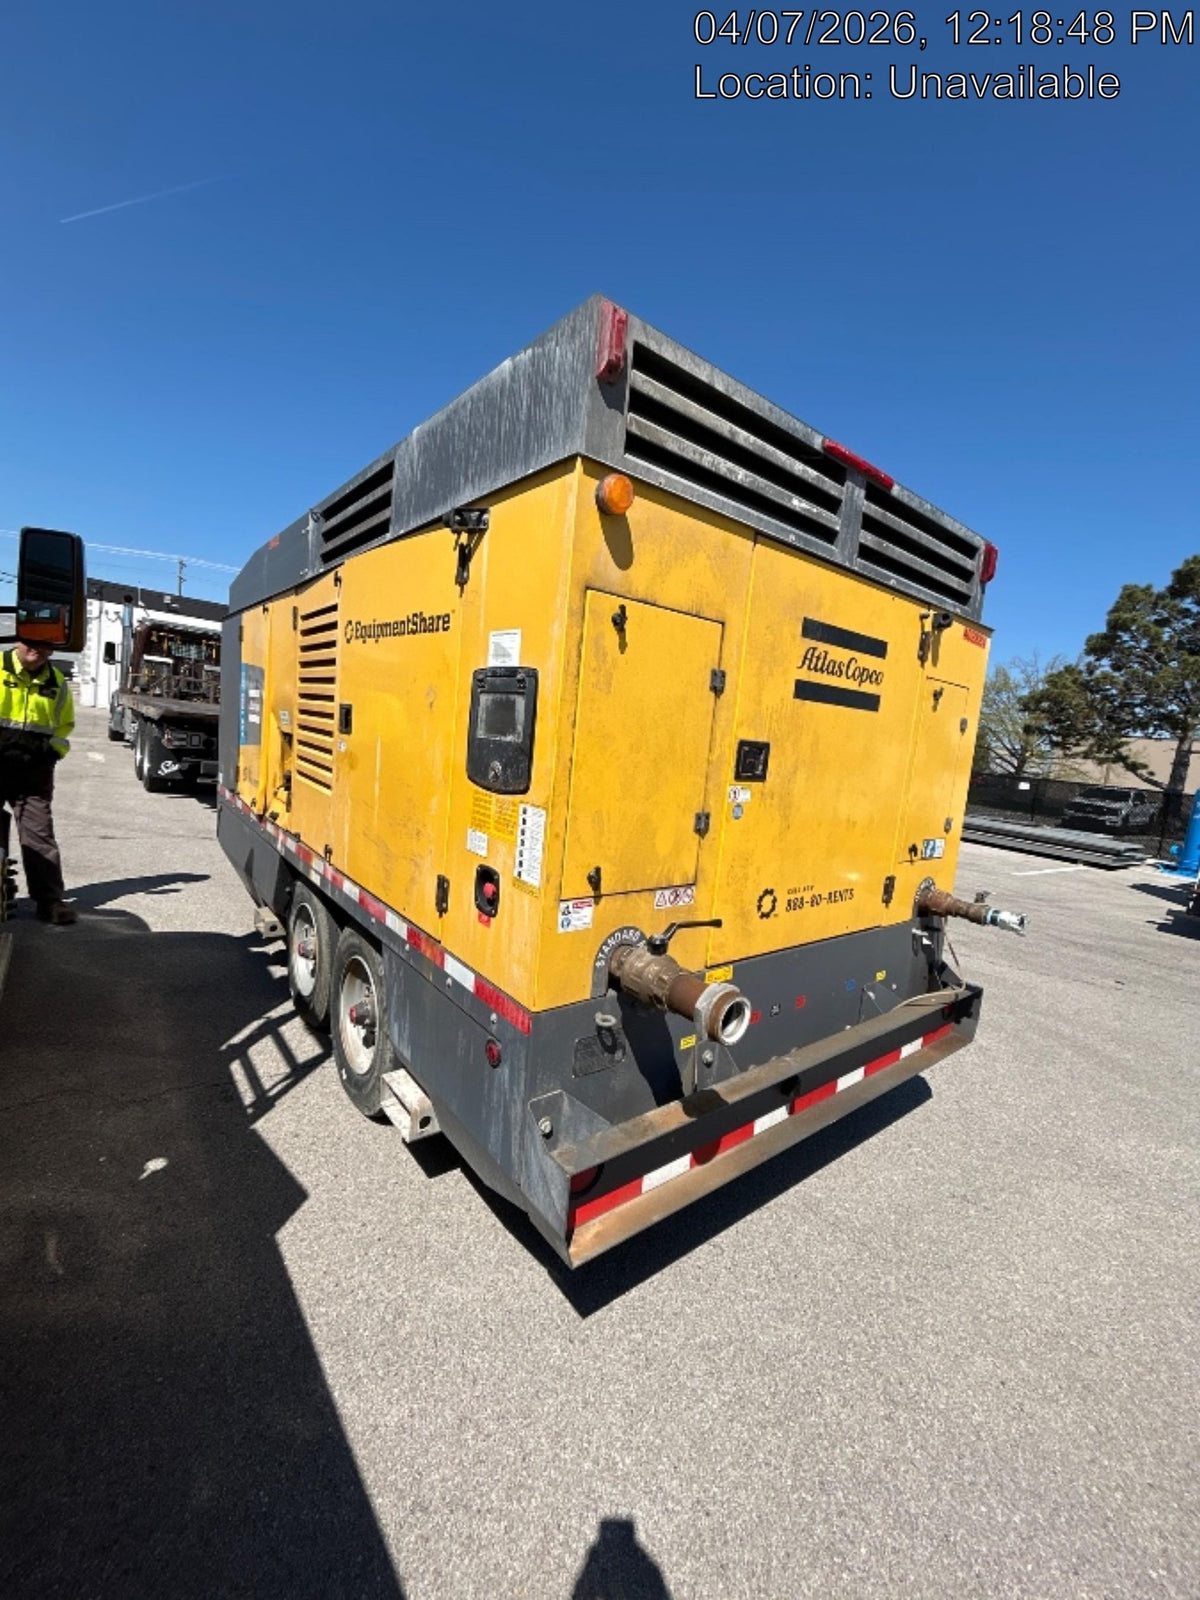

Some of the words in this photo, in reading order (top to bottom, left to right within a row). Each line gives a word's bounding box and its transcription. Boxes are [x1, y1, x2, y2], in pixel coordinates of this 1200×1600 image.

[354, 611, 451, 644] EquipmentShare
[796, 646, 845, 678] Atlas
[845, 657, 884, 687] Copco
